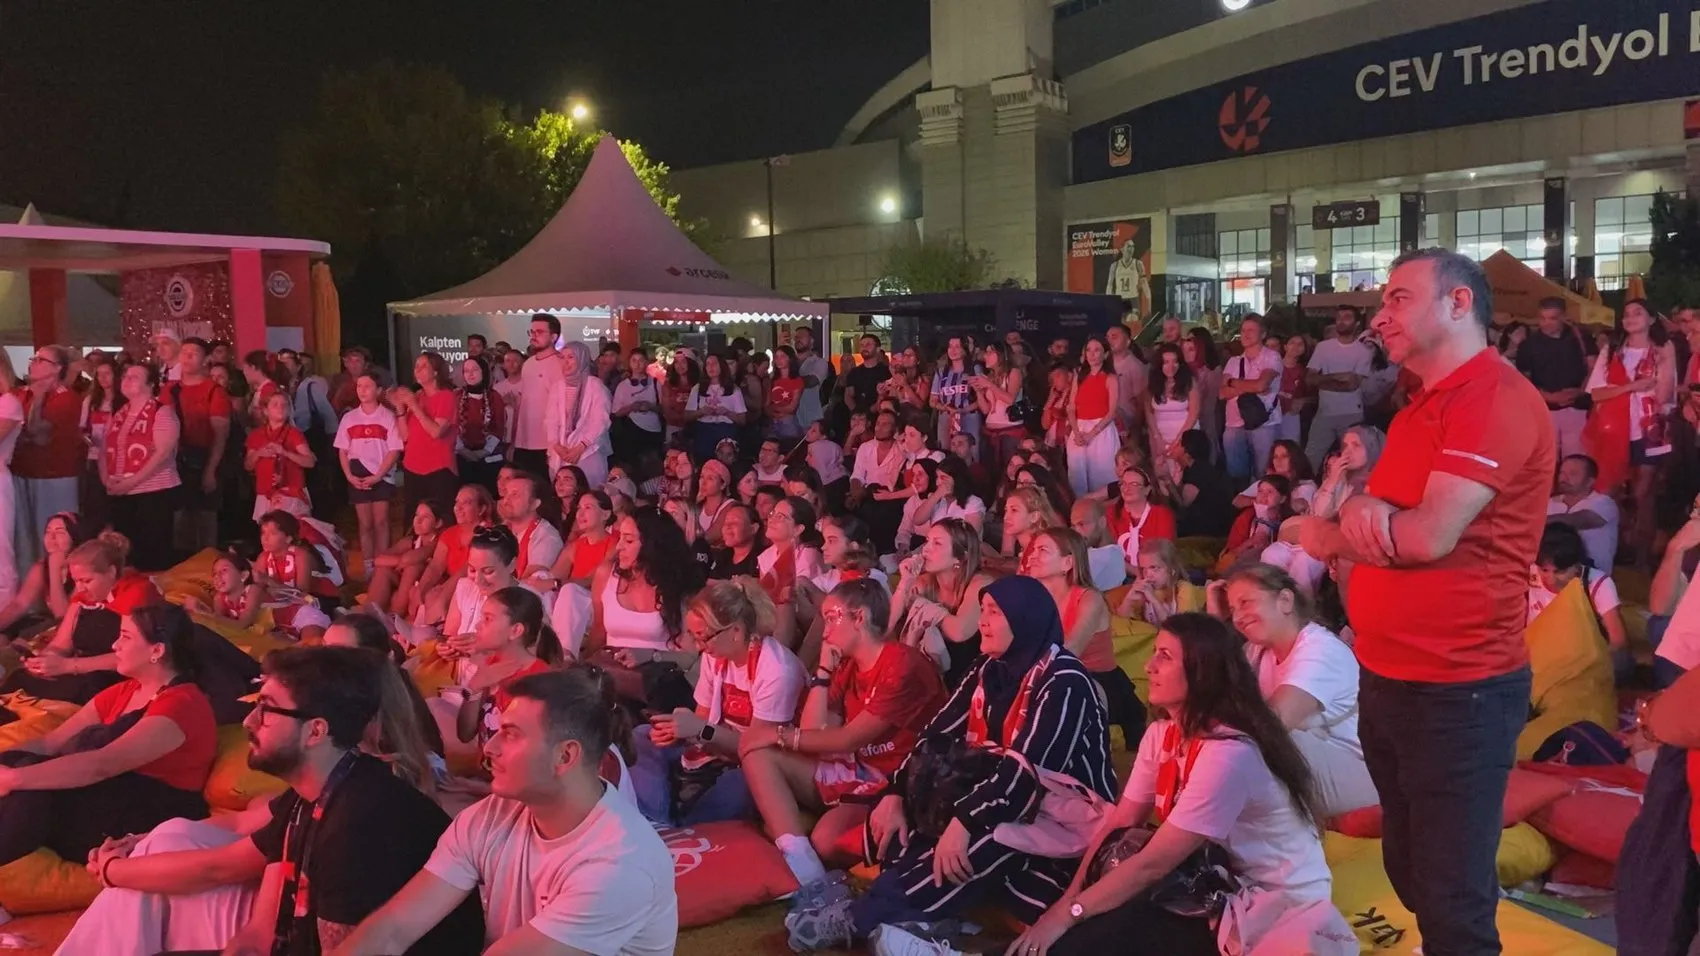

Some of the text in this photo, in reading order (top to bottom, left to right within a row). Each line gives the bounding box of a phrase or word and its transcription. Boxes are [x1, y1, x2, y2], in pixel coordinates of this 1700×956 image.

[1355, 52, 1443, 101] CEV
[1454, 13, 1668, 85] Trendyol
[1327, 210, 1338, 223] 4
[1356, 207, 1366, 221] 3
[1072, 232, 1088, 240] CEV
[420, 336, 462, 350] Kalpten
[941, 384, 968, 396] ESTE
